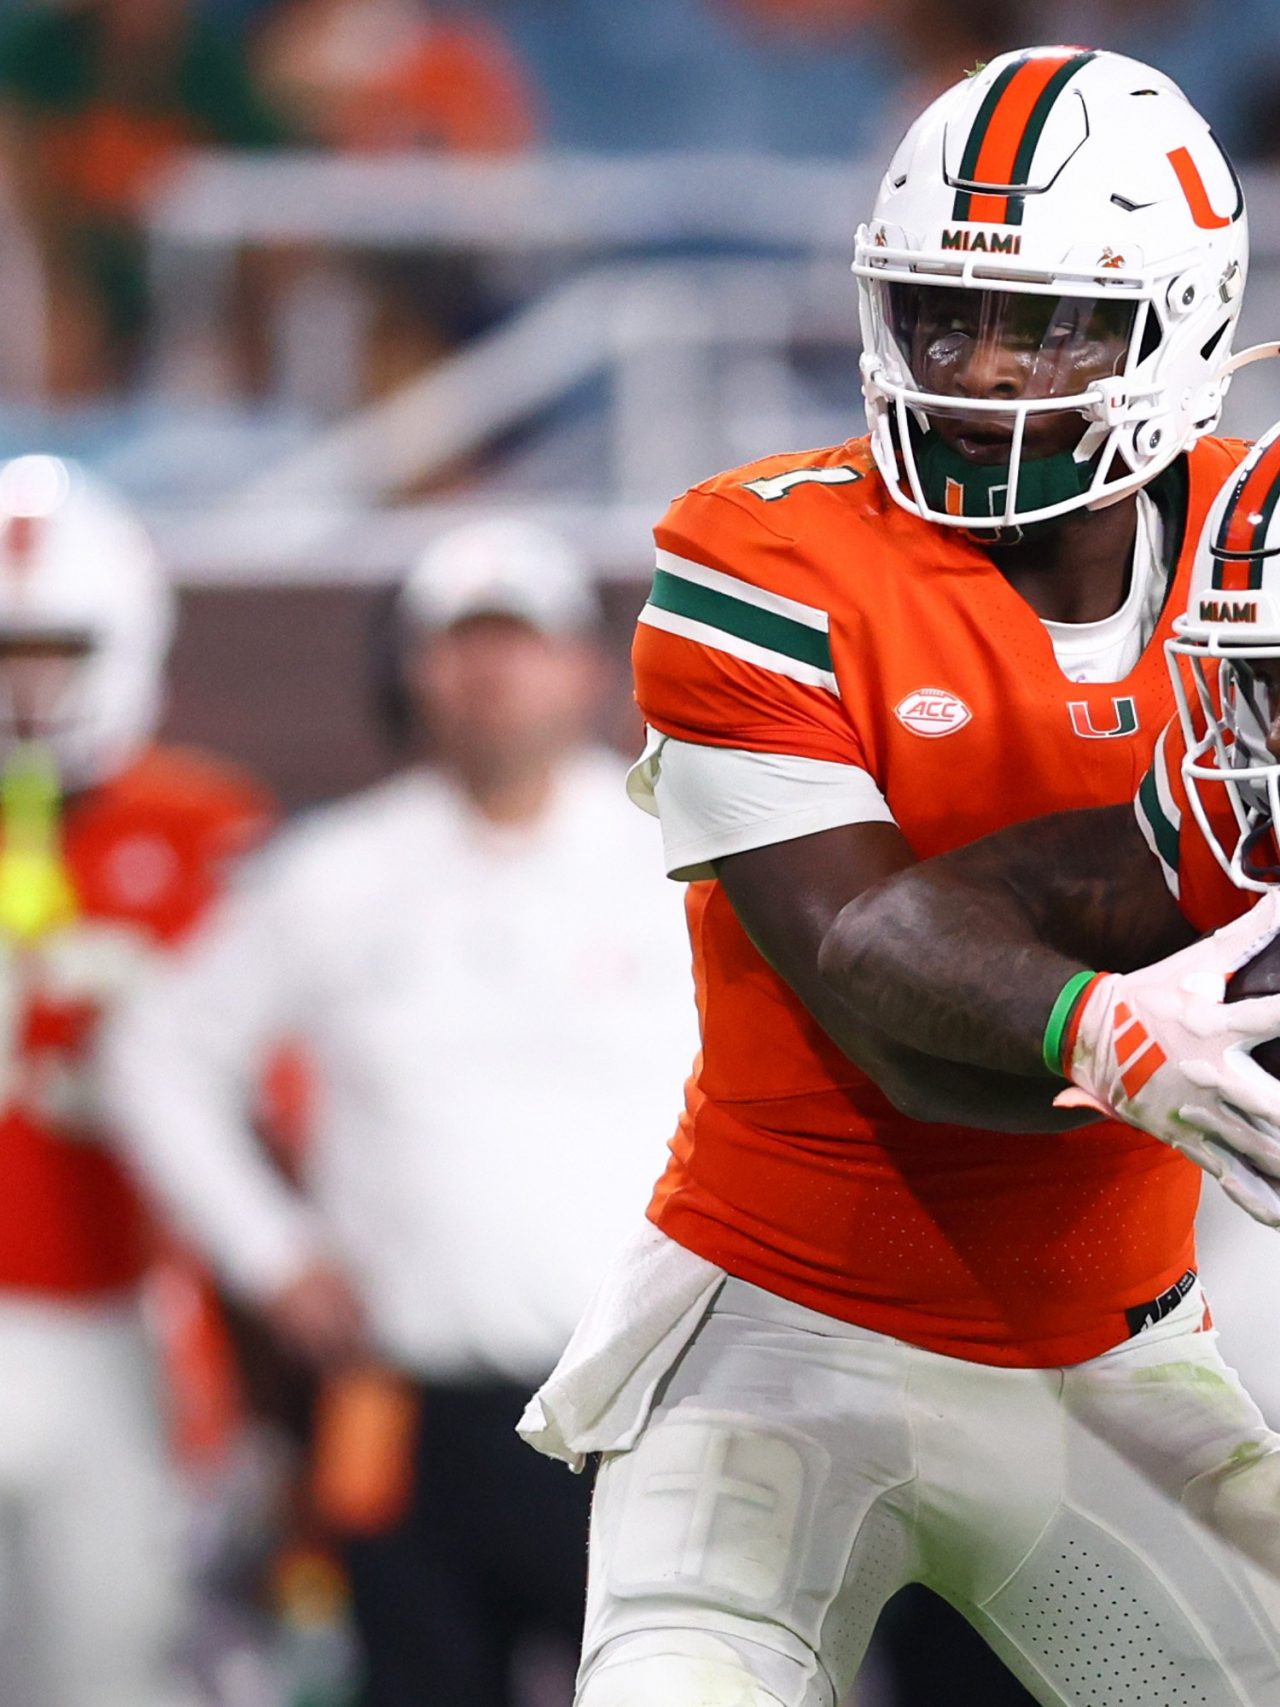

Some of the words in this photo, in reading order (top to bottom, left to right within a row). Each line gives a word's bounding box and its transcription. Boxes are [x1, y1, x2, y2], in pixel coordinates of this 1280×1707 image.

[941, 229, 1021, 255] MIAMI
[741, 465, 864, 501] 1
[1200, 601, 1257, 623] MIAMI
[906, 700, 958, 718] ACC
[1067, 697, 1139, 738] U
